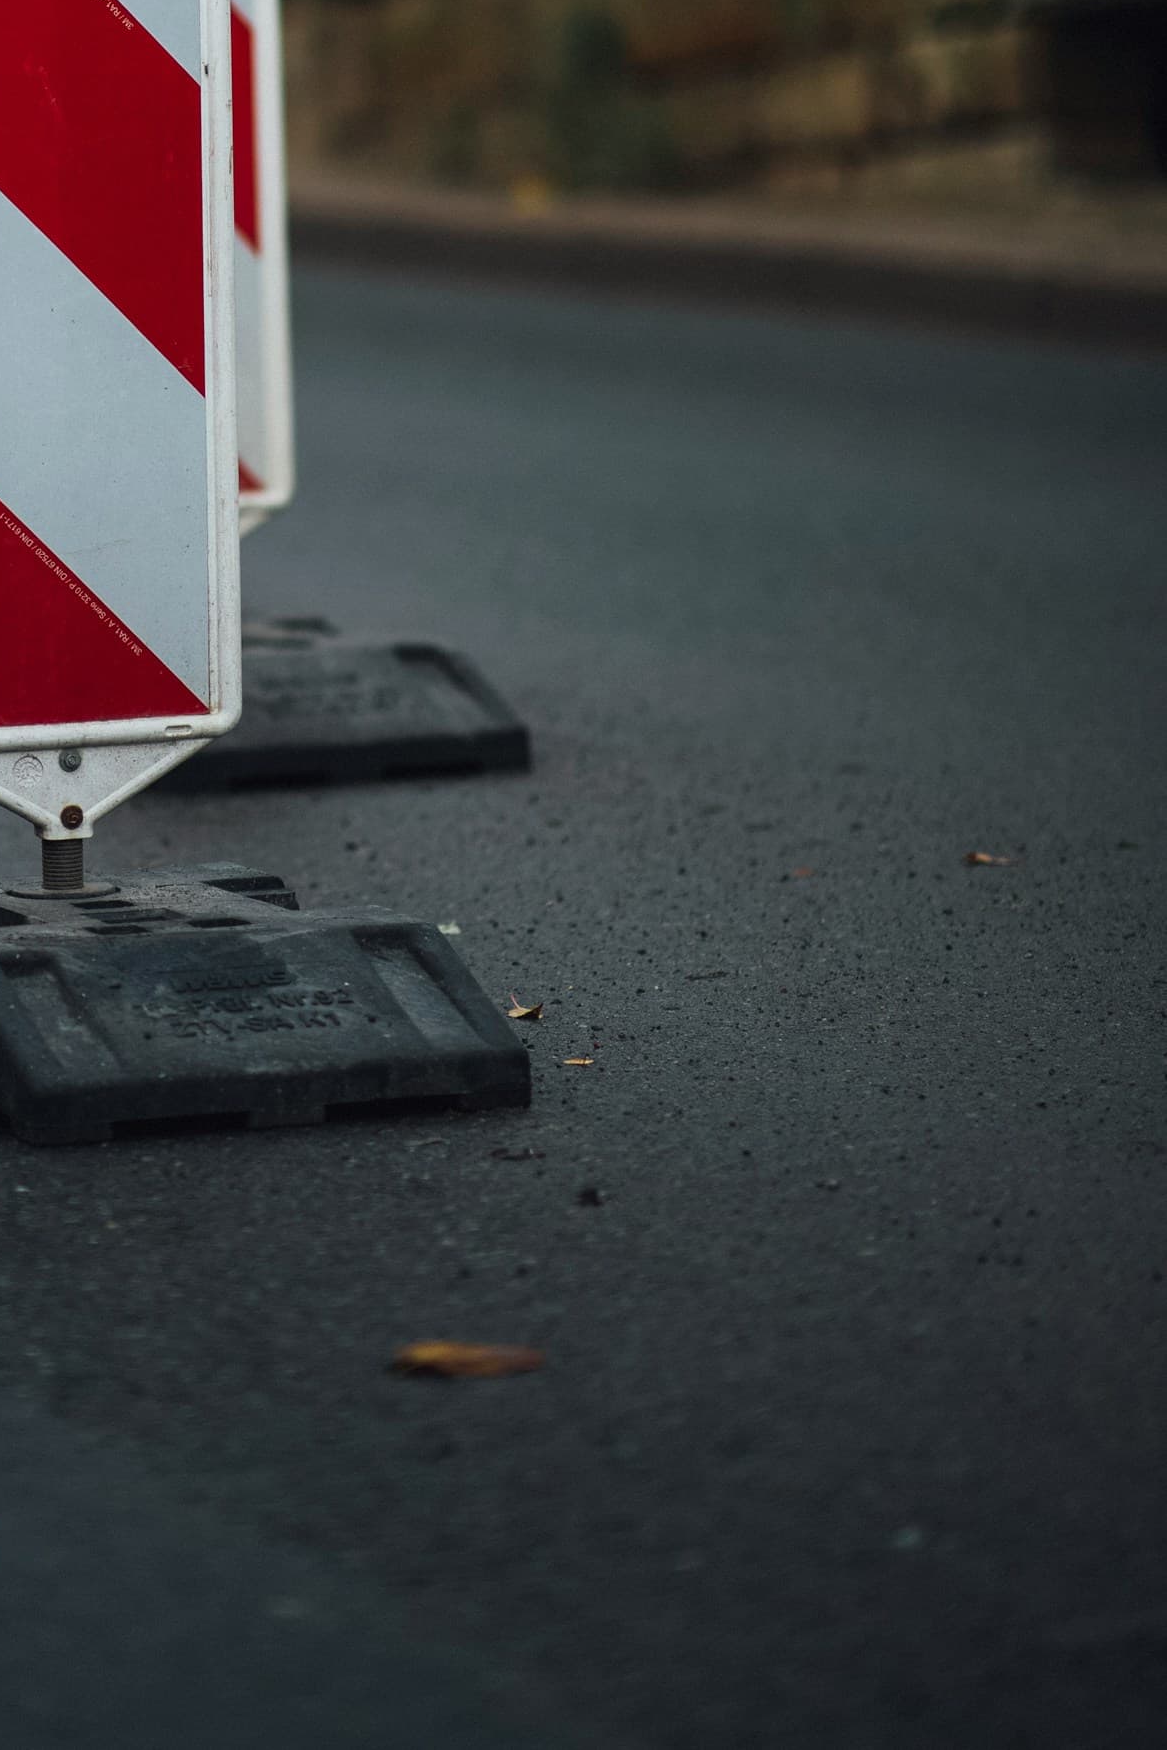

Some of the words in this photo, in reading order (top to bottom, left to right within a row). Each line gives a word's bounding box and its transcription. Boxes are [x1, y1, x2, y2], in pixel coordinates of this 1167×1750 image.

[0, 513, 22, 535] 6171-1
[19, 532, 34, 548] DIN
[35, 548, 56, 569] 67520
[53, 565, 68, 581] DIN
[74, 586, 92, 604] 3210
